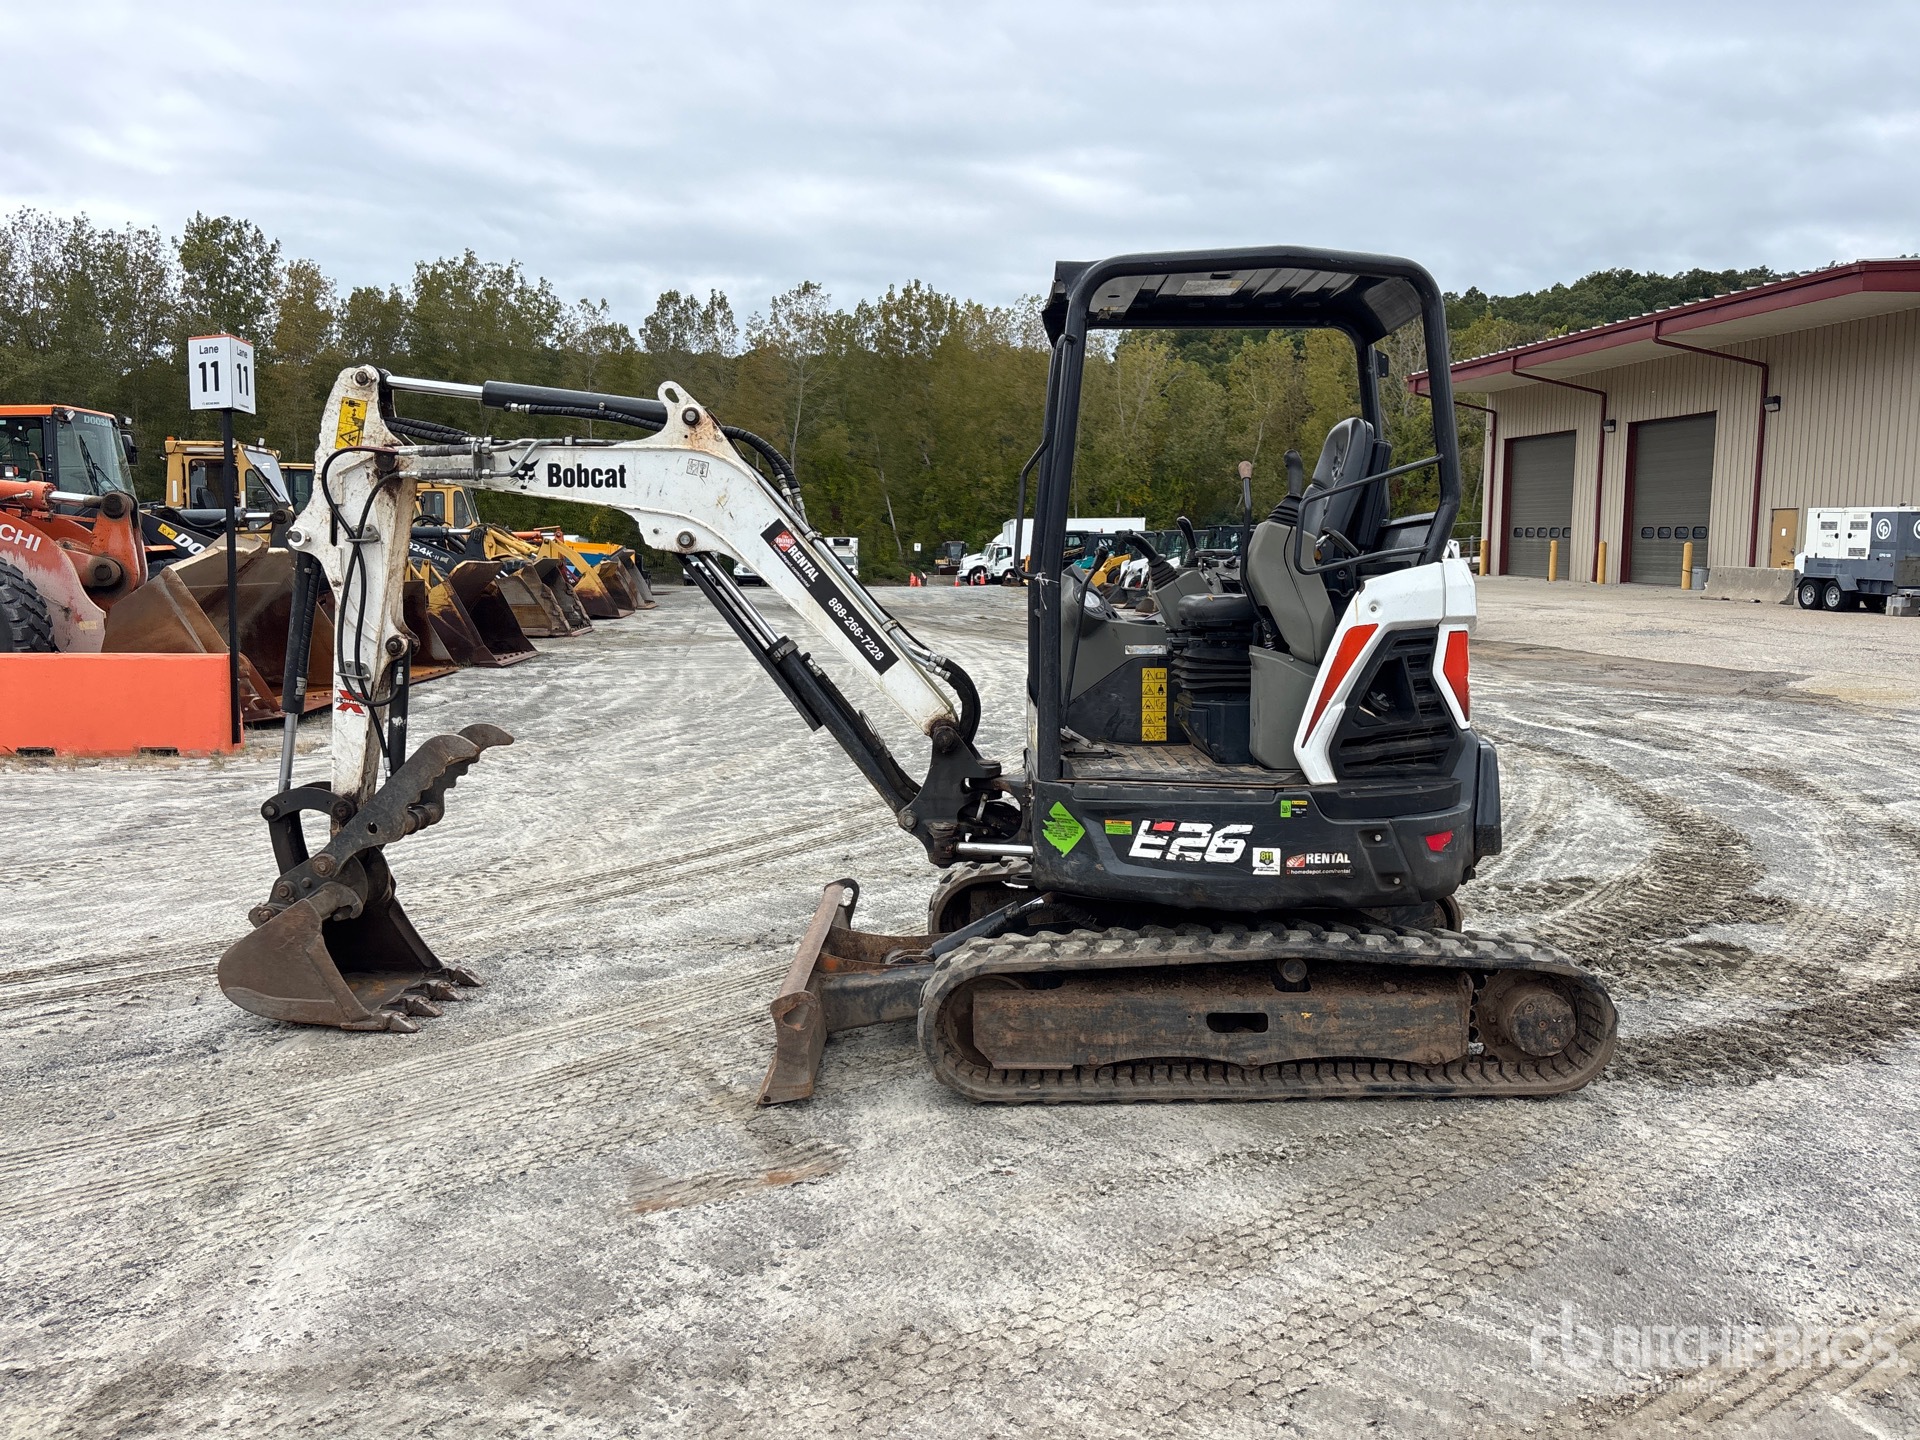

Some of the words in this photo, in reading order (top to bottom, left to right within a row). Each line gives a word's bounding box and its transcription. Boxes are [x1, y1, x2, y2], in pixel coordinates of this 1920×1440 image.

[199, 345, 219, 354] Lane
[236, 346, 248, 359] Lane
[198, 361, 219, 392] 11
[236, 363, 249, 396] 11
[83, 415, 109, 427] DOOSA
[547, 463, 627, 489] Bobcat
[0, 523, 42, 552] CHI
[773, 543, 811, 588] homedepot.com/rental
[787, 545, 820, 583] RENTAL
[828, 597, 885, 662] 888-266-7228
[1128, 819, 1254, 863] E26
[1260, 852, 1273, 861] 811
[1305, 852, 1351, 864] RENTAL
